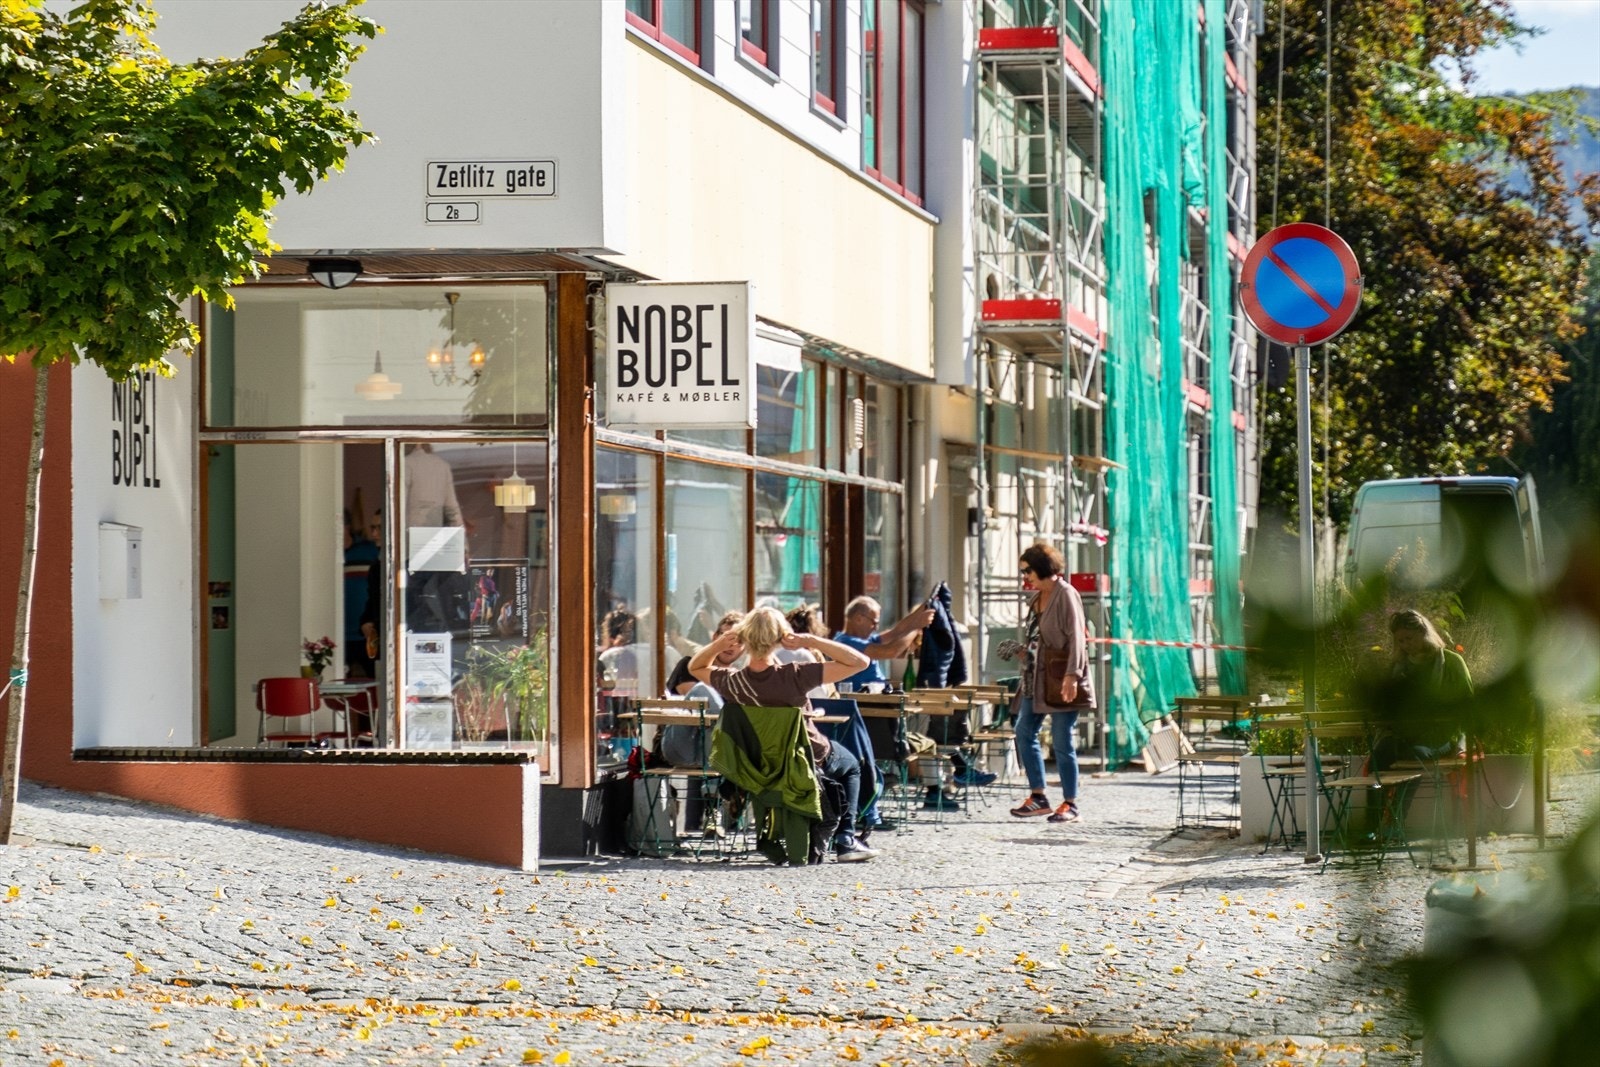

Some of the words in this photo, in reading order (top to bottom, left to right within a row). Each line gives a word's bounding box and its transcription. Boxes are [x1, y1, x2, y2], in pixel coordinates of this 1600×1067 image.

[436, 164, 495, 188] Zetlitz
[506, 165, 546, 193] gate
[446, 205, 459, 219] 2B
[617, 304, 740, 347] NOBEL
[617, 391, 654, 402] KAFÉ
[663, 392, 672, 402] &
[680, 391, 740, 402] MØBLER
